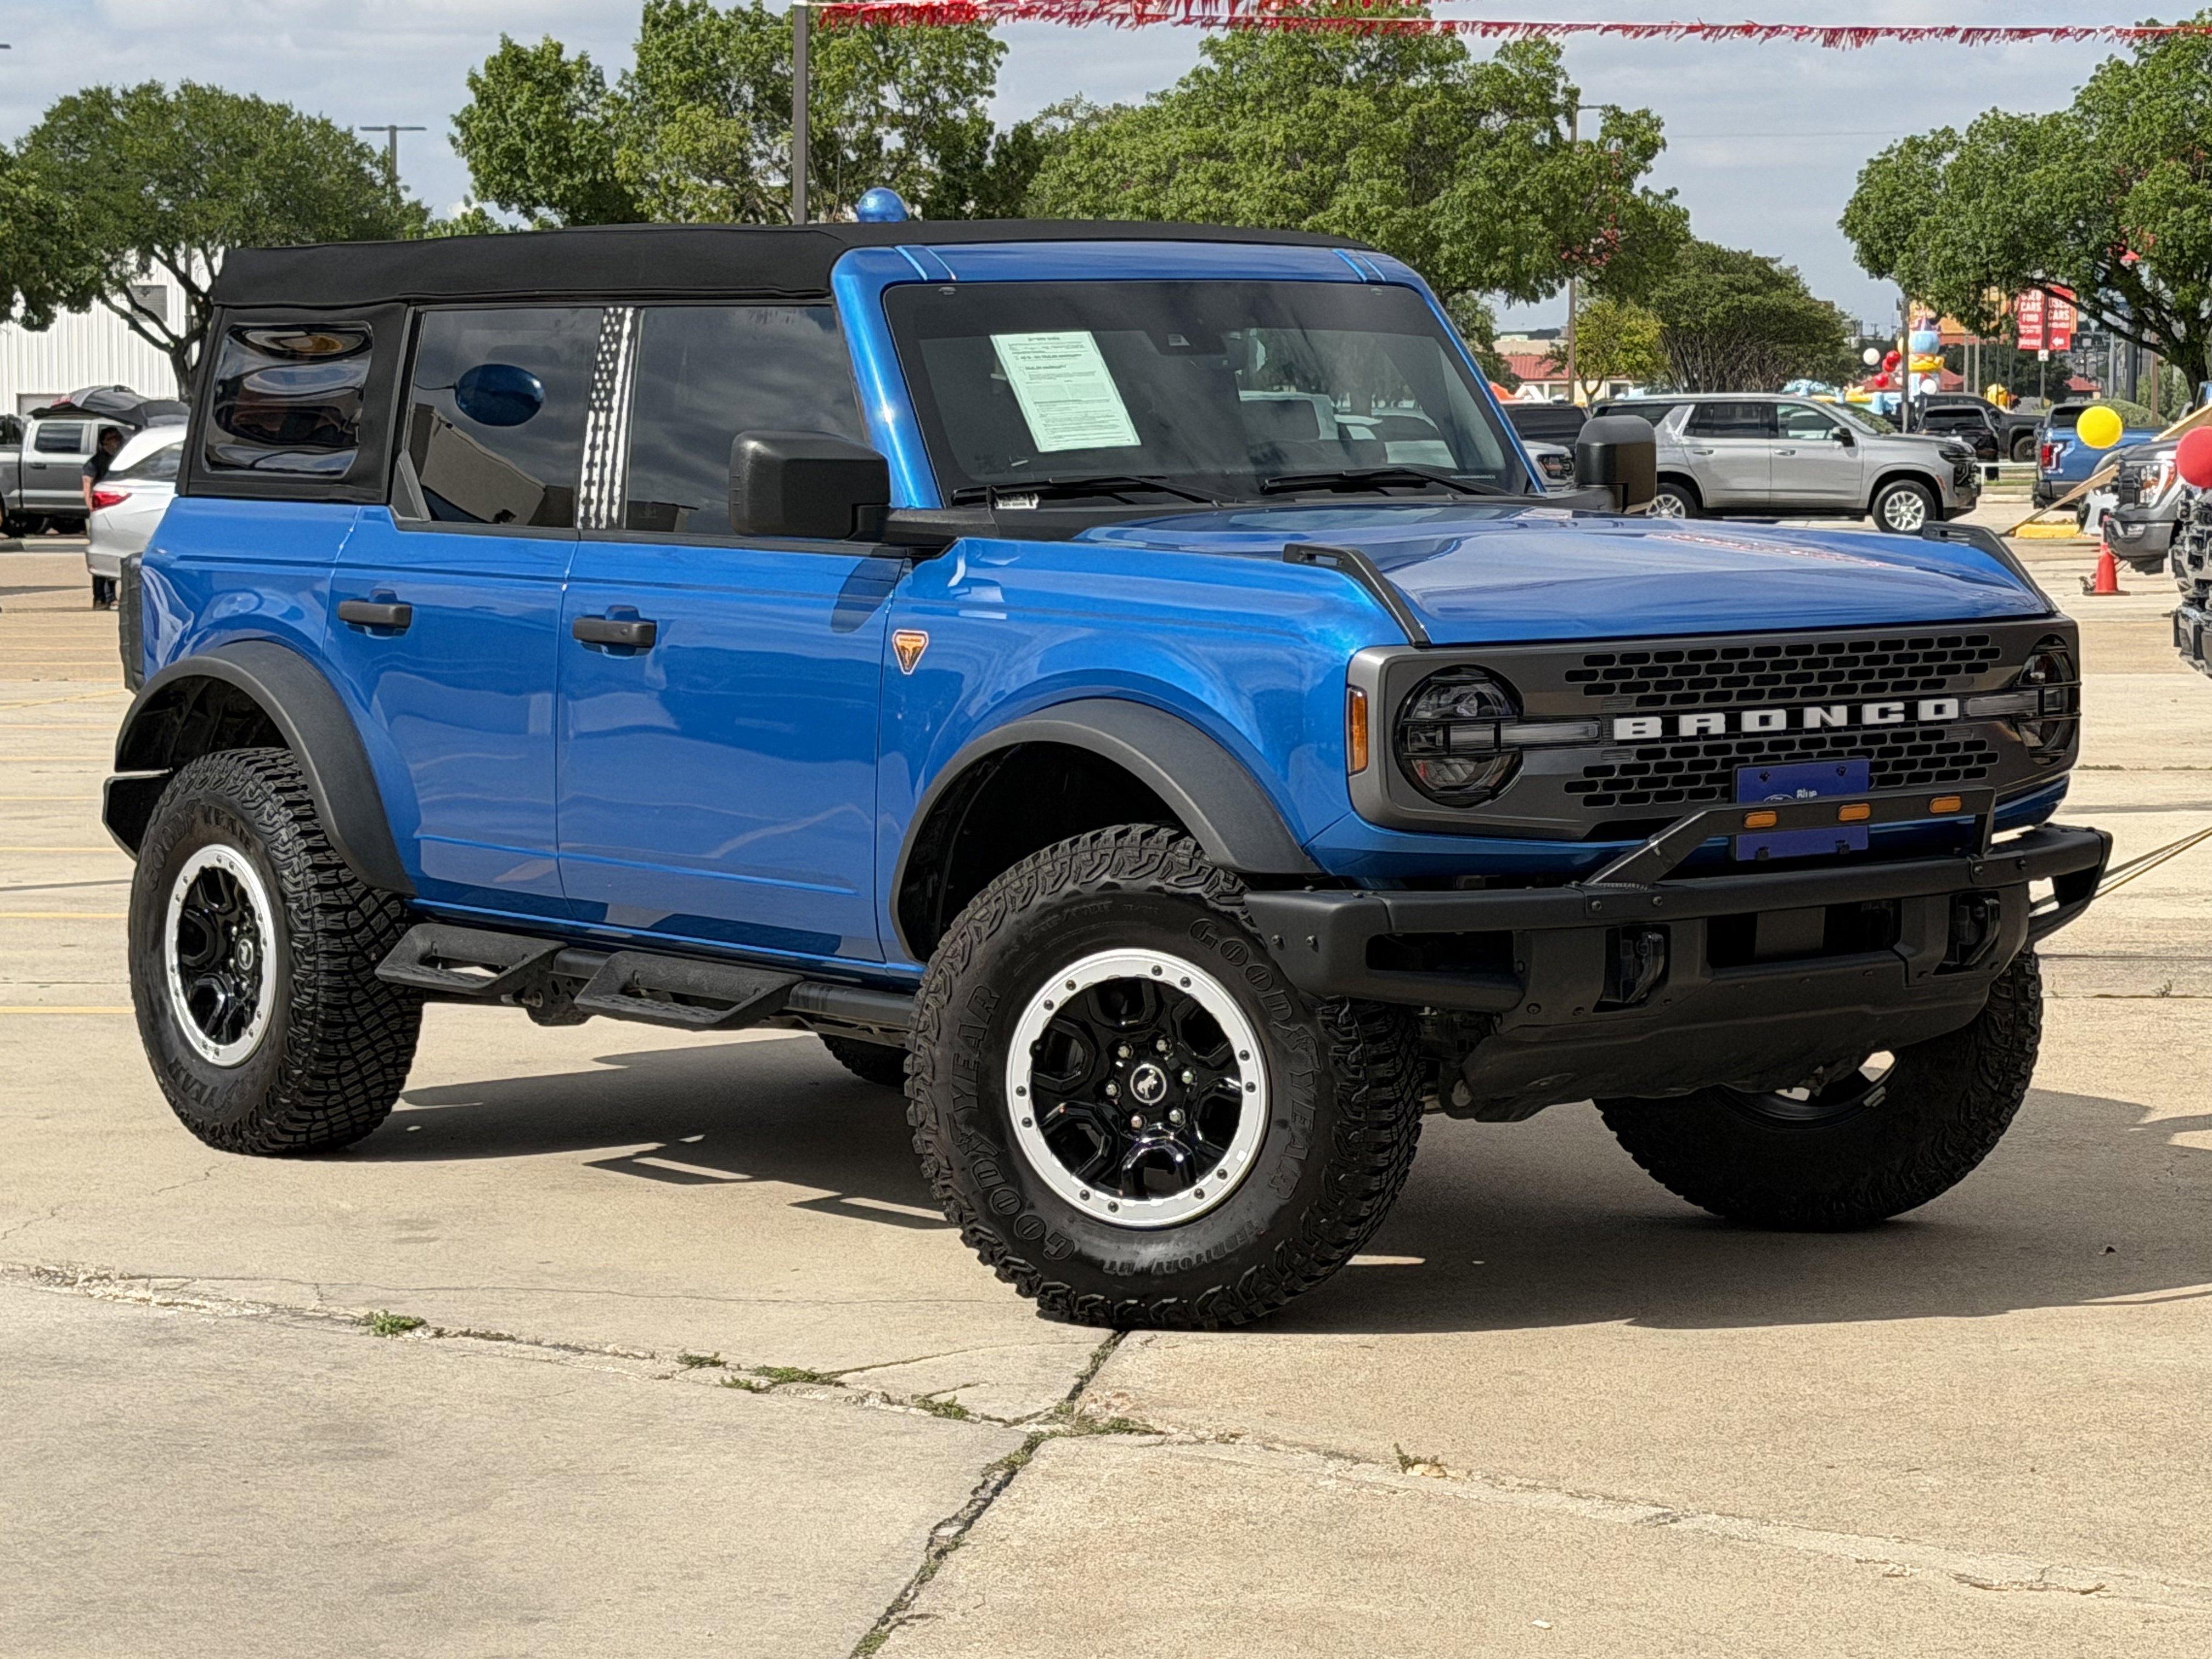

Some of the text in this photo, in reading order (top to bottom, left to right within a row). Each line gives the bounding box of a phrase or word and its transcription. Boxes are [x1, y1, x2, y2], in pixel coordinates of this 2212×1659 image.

[2021, 302, 2041, 312] CARS
[2048, 309, 2070, 320] CARS
[1613, 698, 1959, 741] BRONCO
[1189, 918, 1321, 1200] GOODYEAR
[946, 985, 1075, 1261] GOODYEAR
